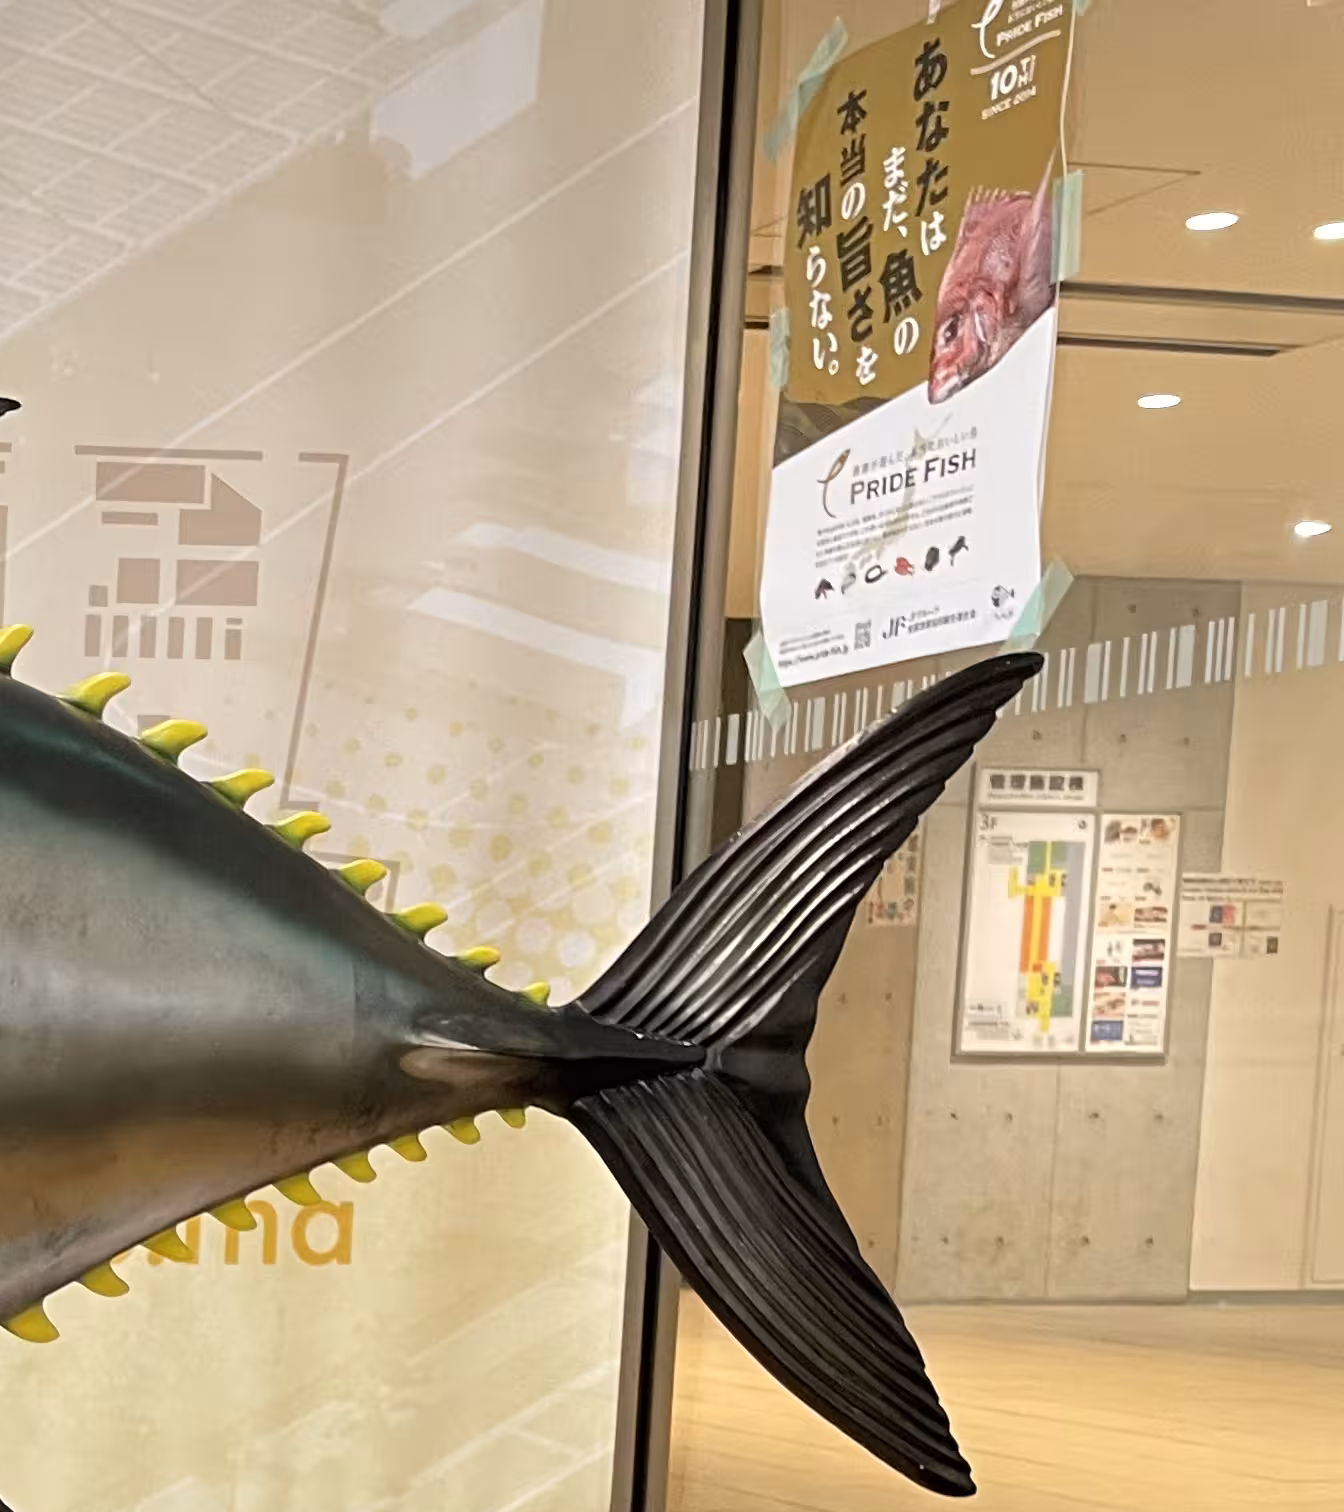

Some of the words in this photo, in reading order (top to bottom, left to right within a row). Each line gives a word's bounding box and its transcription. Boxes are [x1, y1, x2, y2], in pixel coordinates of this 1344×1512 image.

[912, 37, 951, 256] あなたは
[850, 467, 918, 505] PRIDE
[923, 448, 977, 484] FISH
